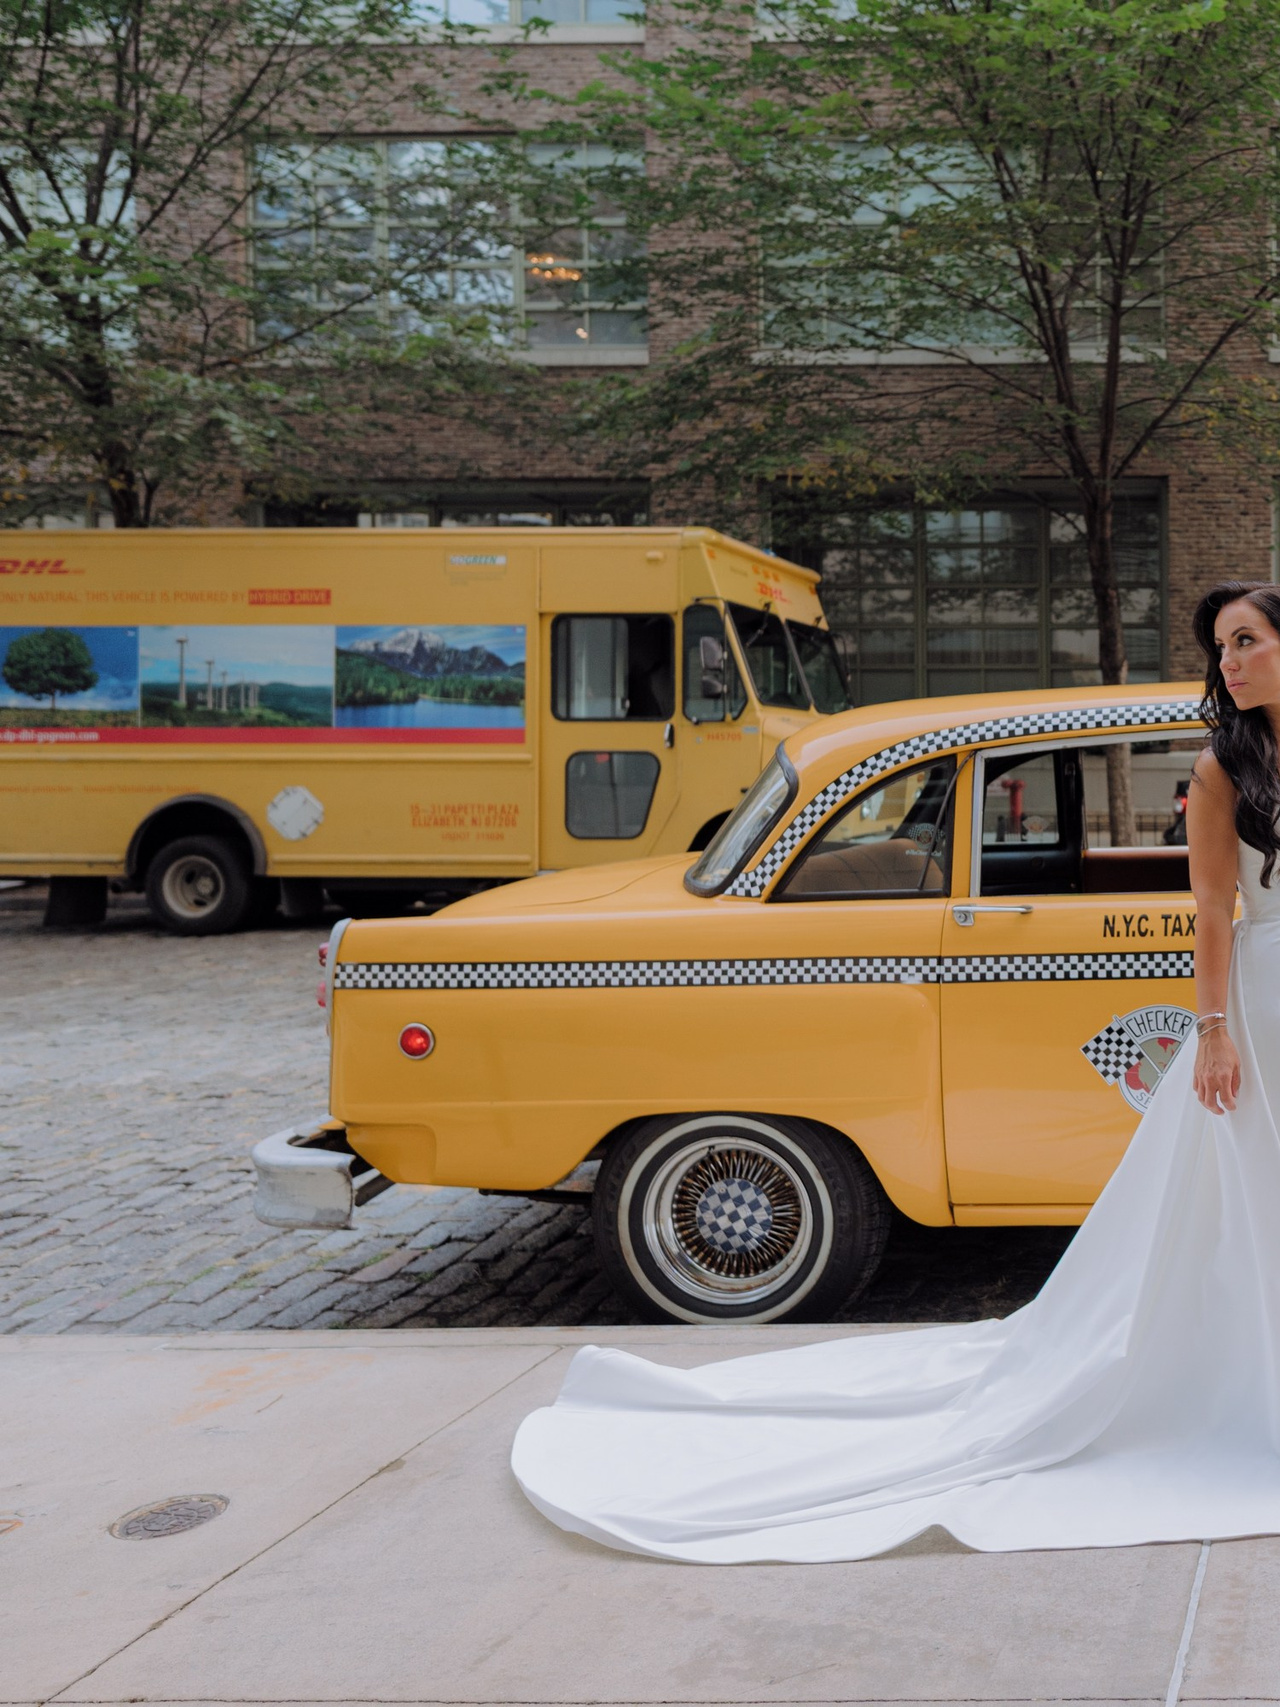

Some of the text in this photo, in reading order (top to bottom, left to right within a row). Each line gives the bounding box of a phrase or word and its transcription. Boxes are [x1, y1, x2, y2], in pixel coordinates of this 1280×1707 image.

[0, 559, 69, 574] DHL
[86, 590, 109, 602] THIS
[112, 590, 156, 602] VEHICLE
[174, 590, 228, 602] POWERED
[231, 590, 245, 602] BY
[757, 581, 784, 602] DHL
[487, 803, 519, 815] PLAZA
[1103, 913, 1196, 938] N.Y.C. TAX
[1125, 1009, 1193, 1038] CHECKER
